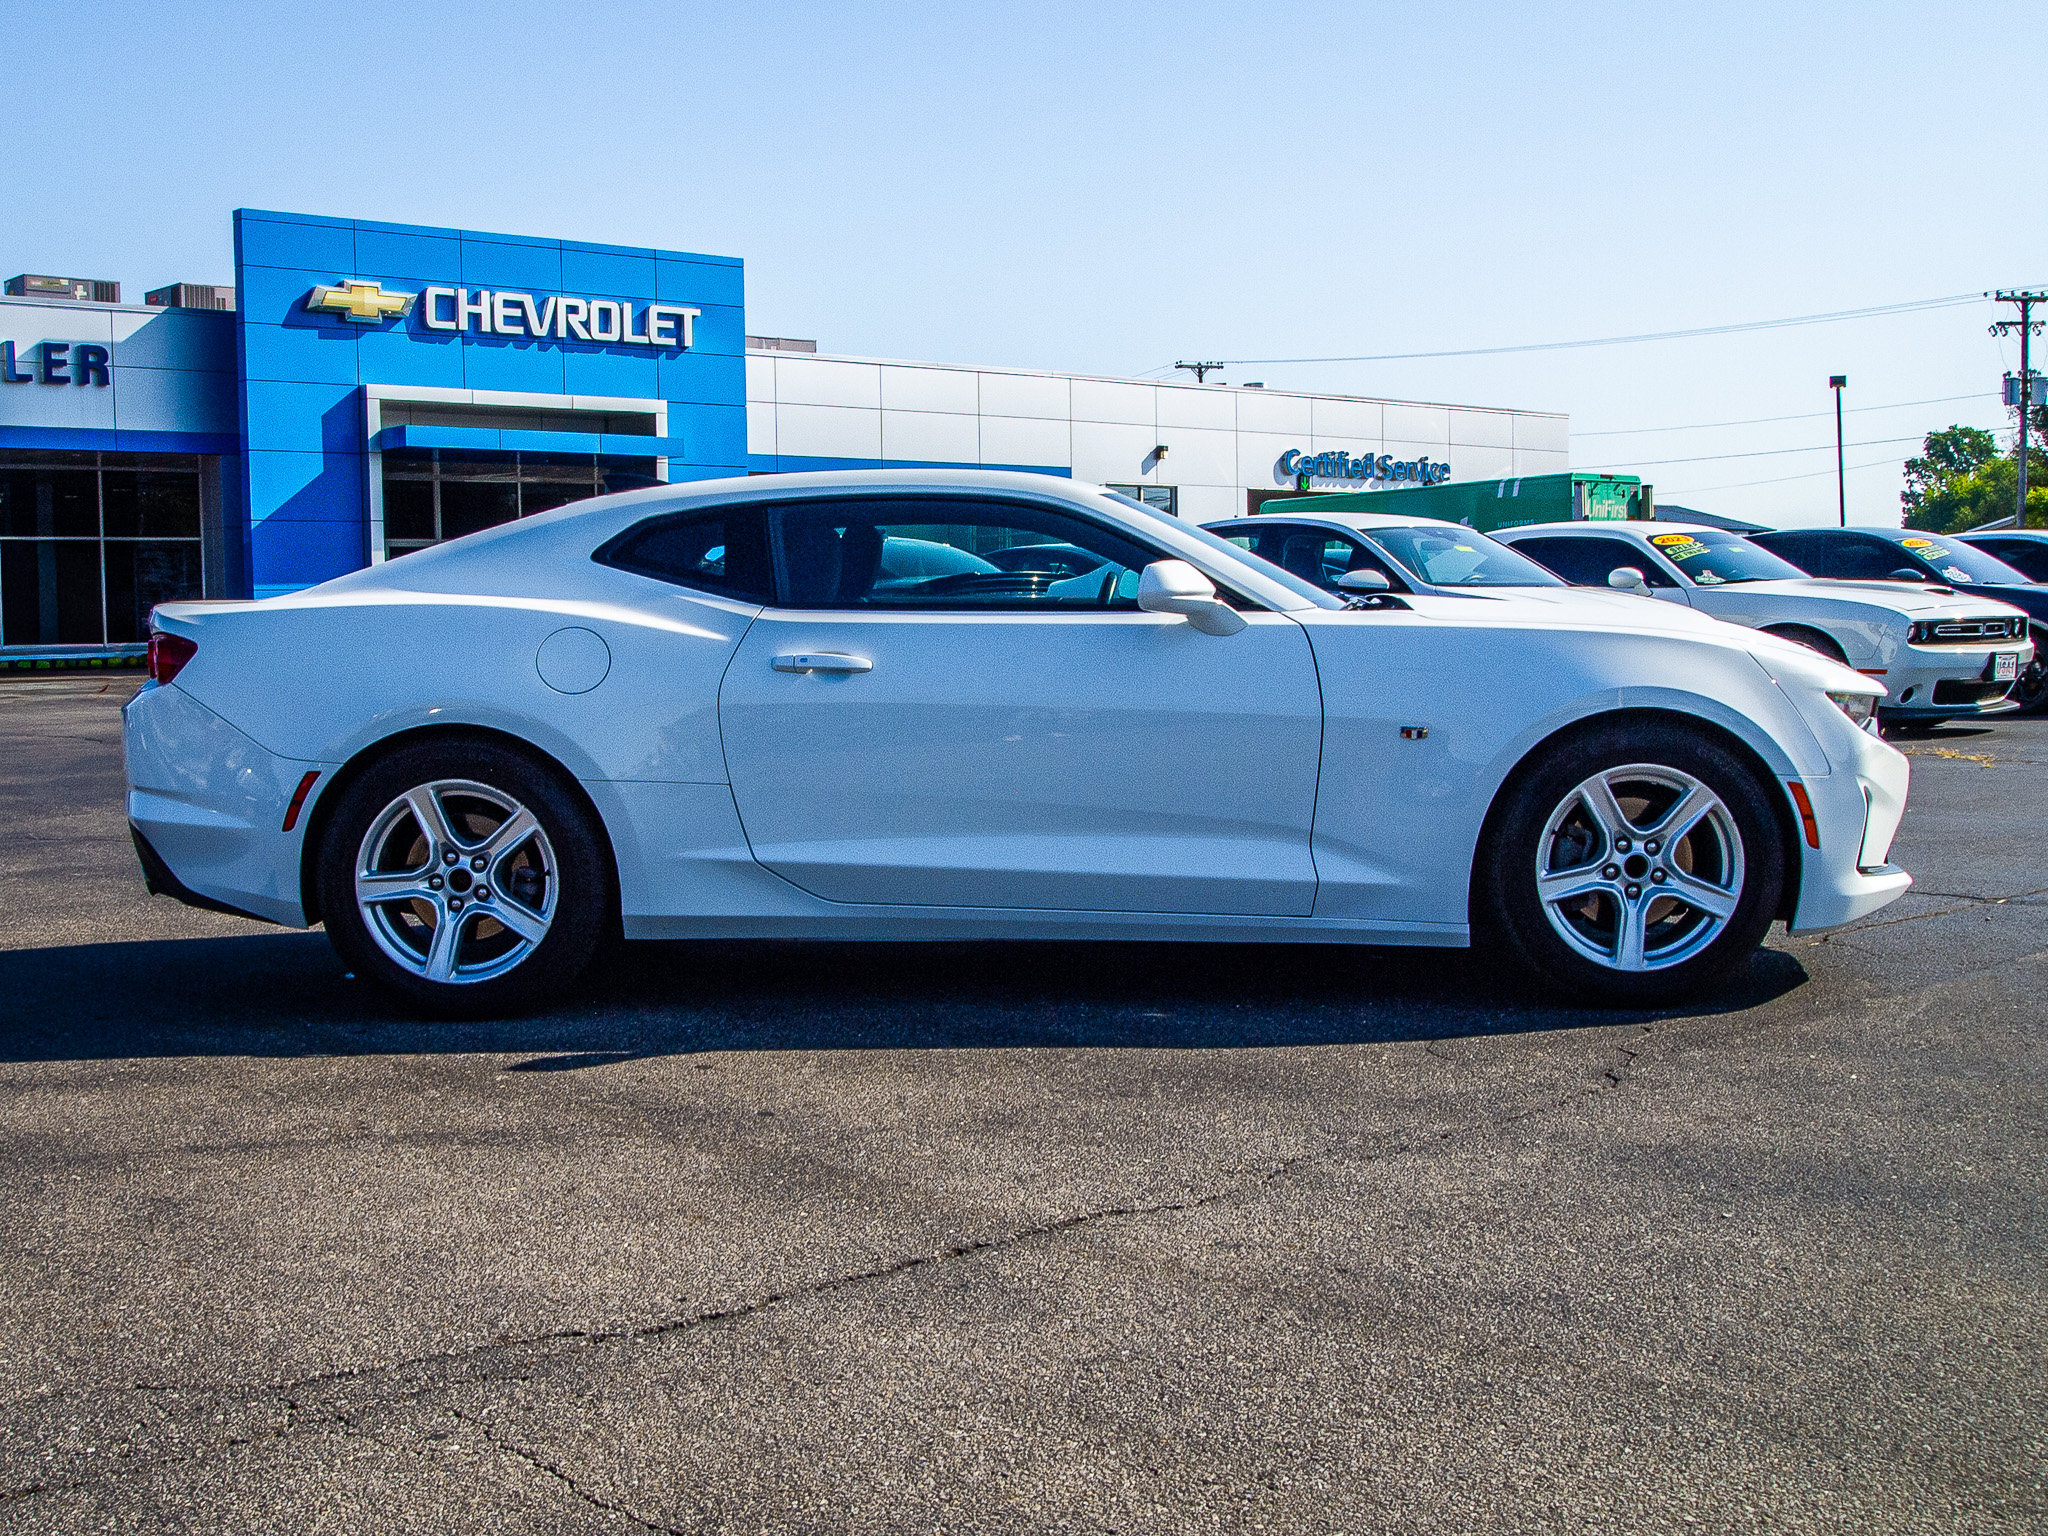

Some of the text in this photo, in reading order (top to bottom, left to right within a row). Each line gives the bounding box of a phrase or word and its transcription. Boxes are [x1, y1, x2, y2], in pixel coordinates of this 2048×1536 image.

[425, 286, 702, 348] CHEVROLET
[2, 340, 110, 386] LER
[1284, 448, 1451, 483] Certified Service
